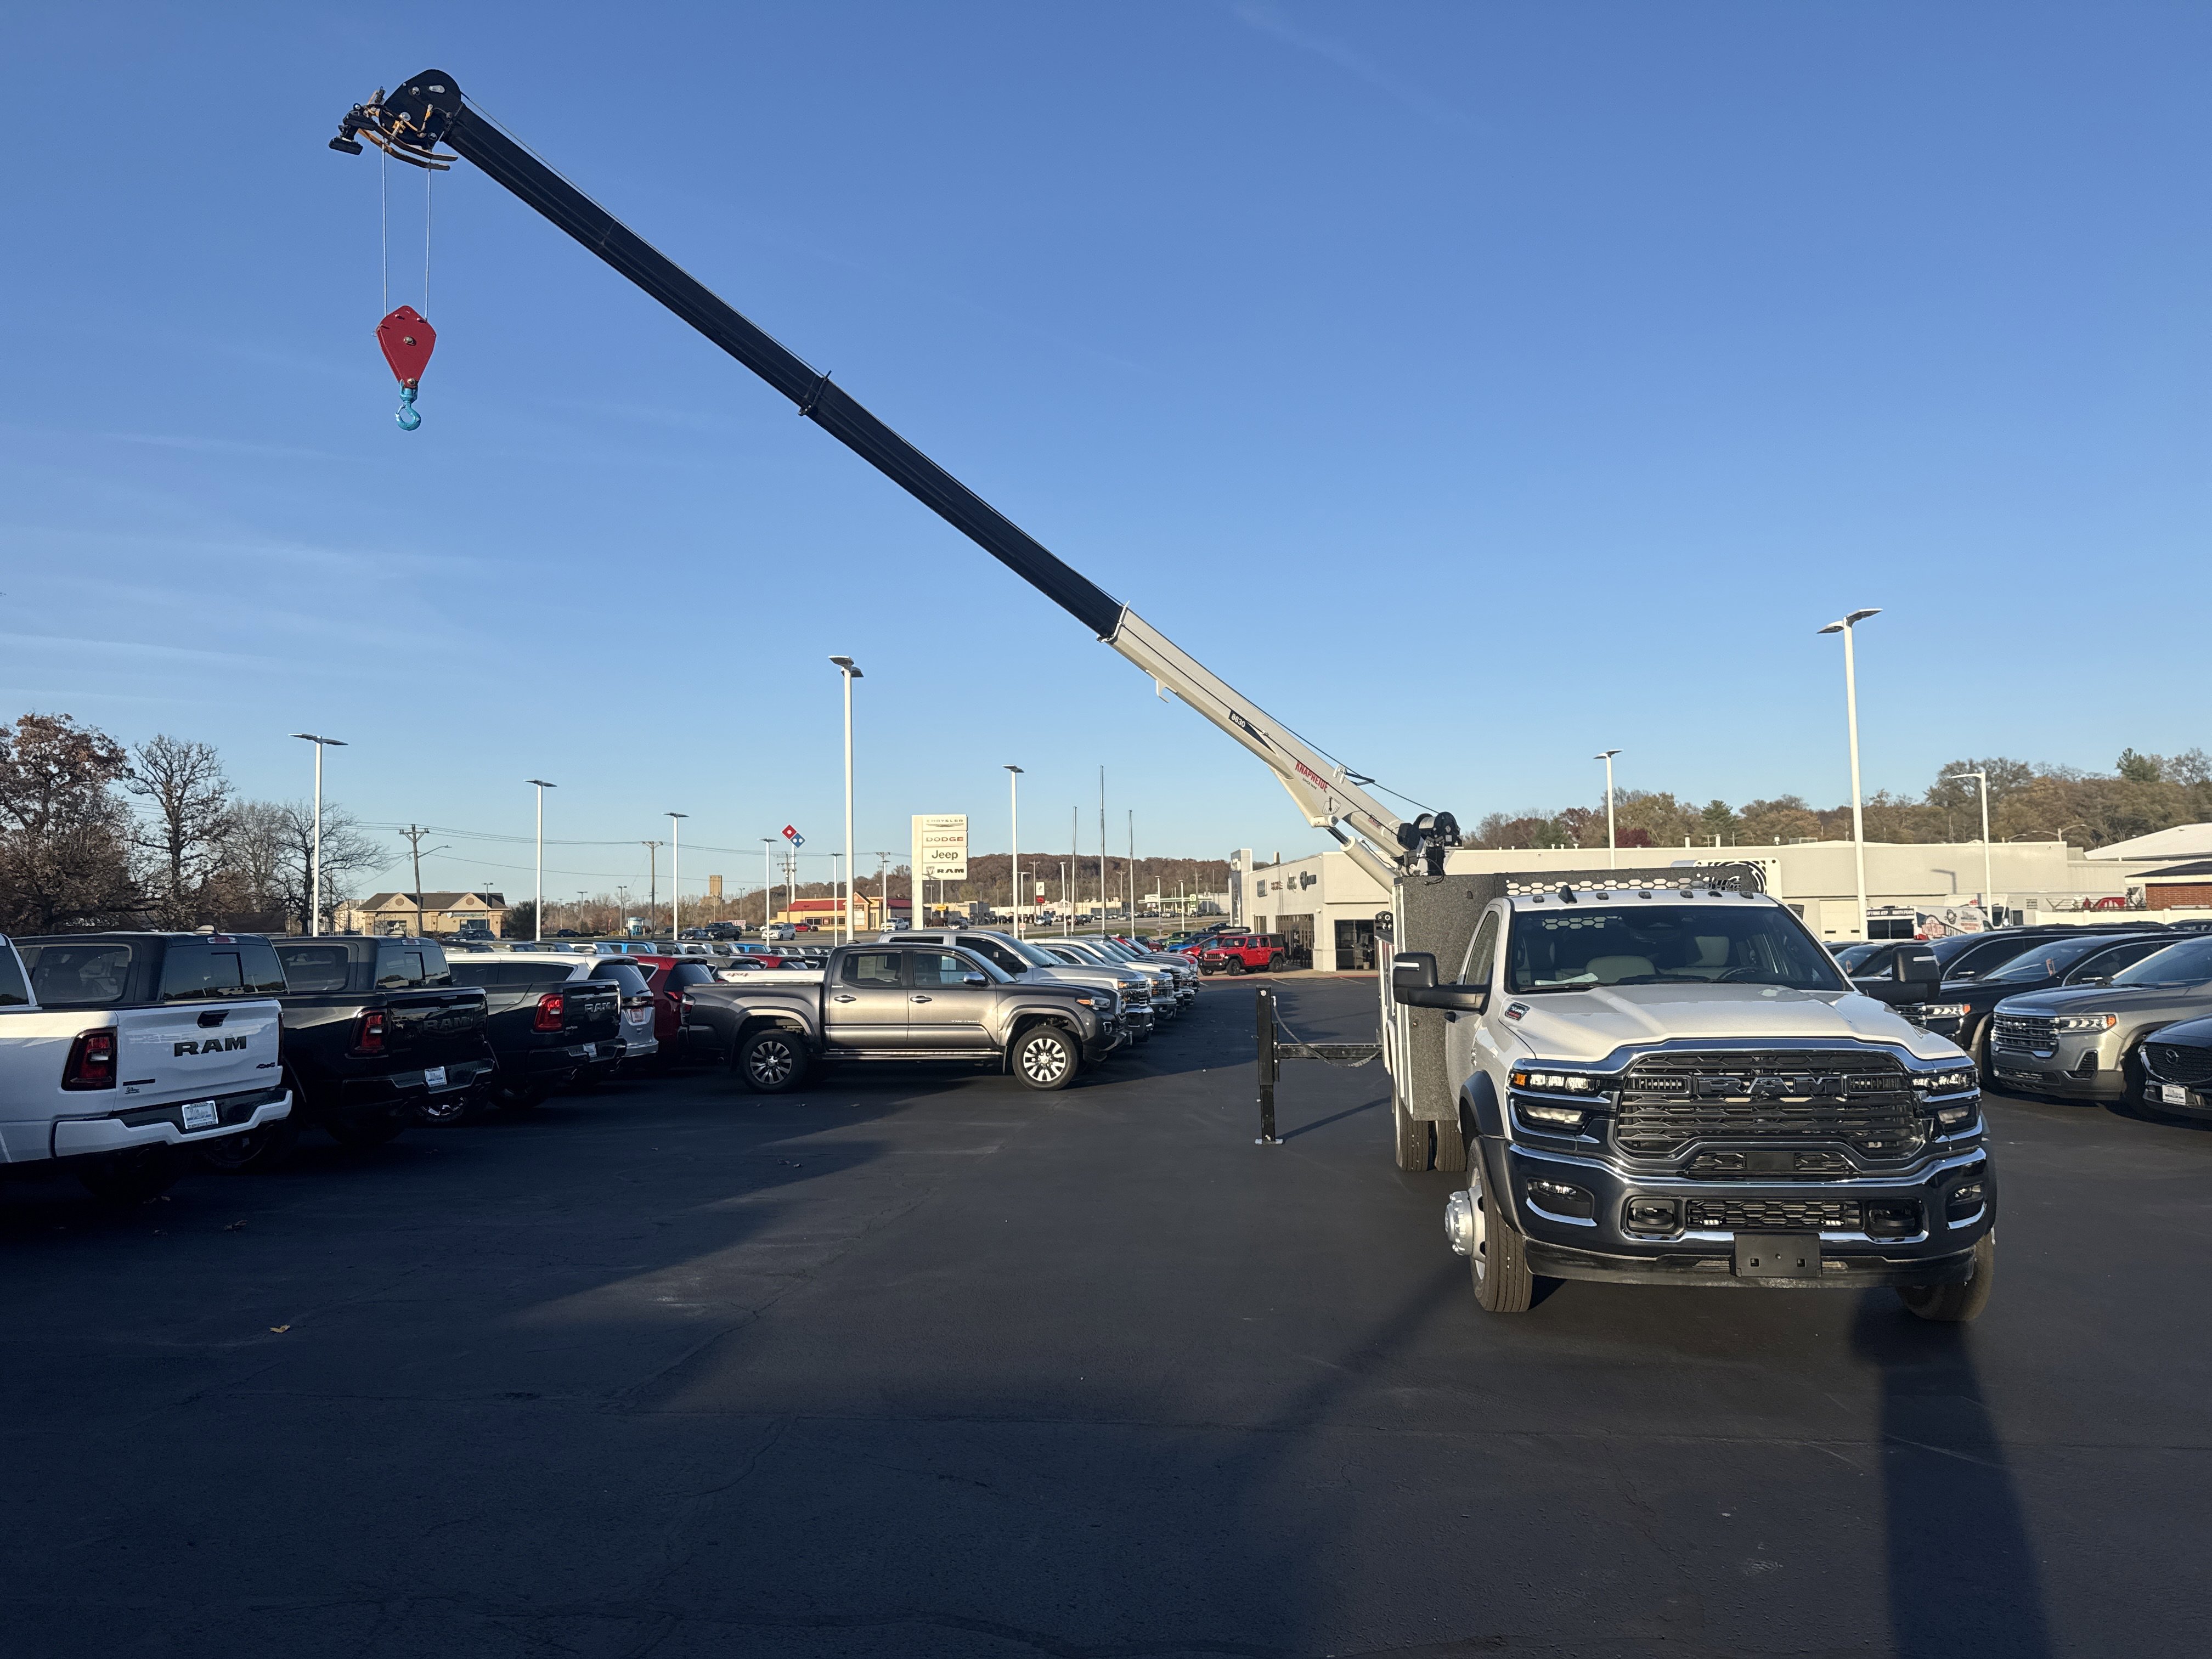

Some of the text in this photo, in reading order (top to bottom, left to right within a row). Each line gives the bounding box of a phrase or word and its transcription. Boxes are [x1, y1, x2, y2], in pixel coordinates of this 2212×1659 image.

[932, 850, 958, 861] Jeep
[584, 1002, 611, 1013] RAM
[423, 1016, 467, 1031] RAM
[174, 1036, 247, 1057] RAM
[1696, 1076, 1841, 1094] RAM
